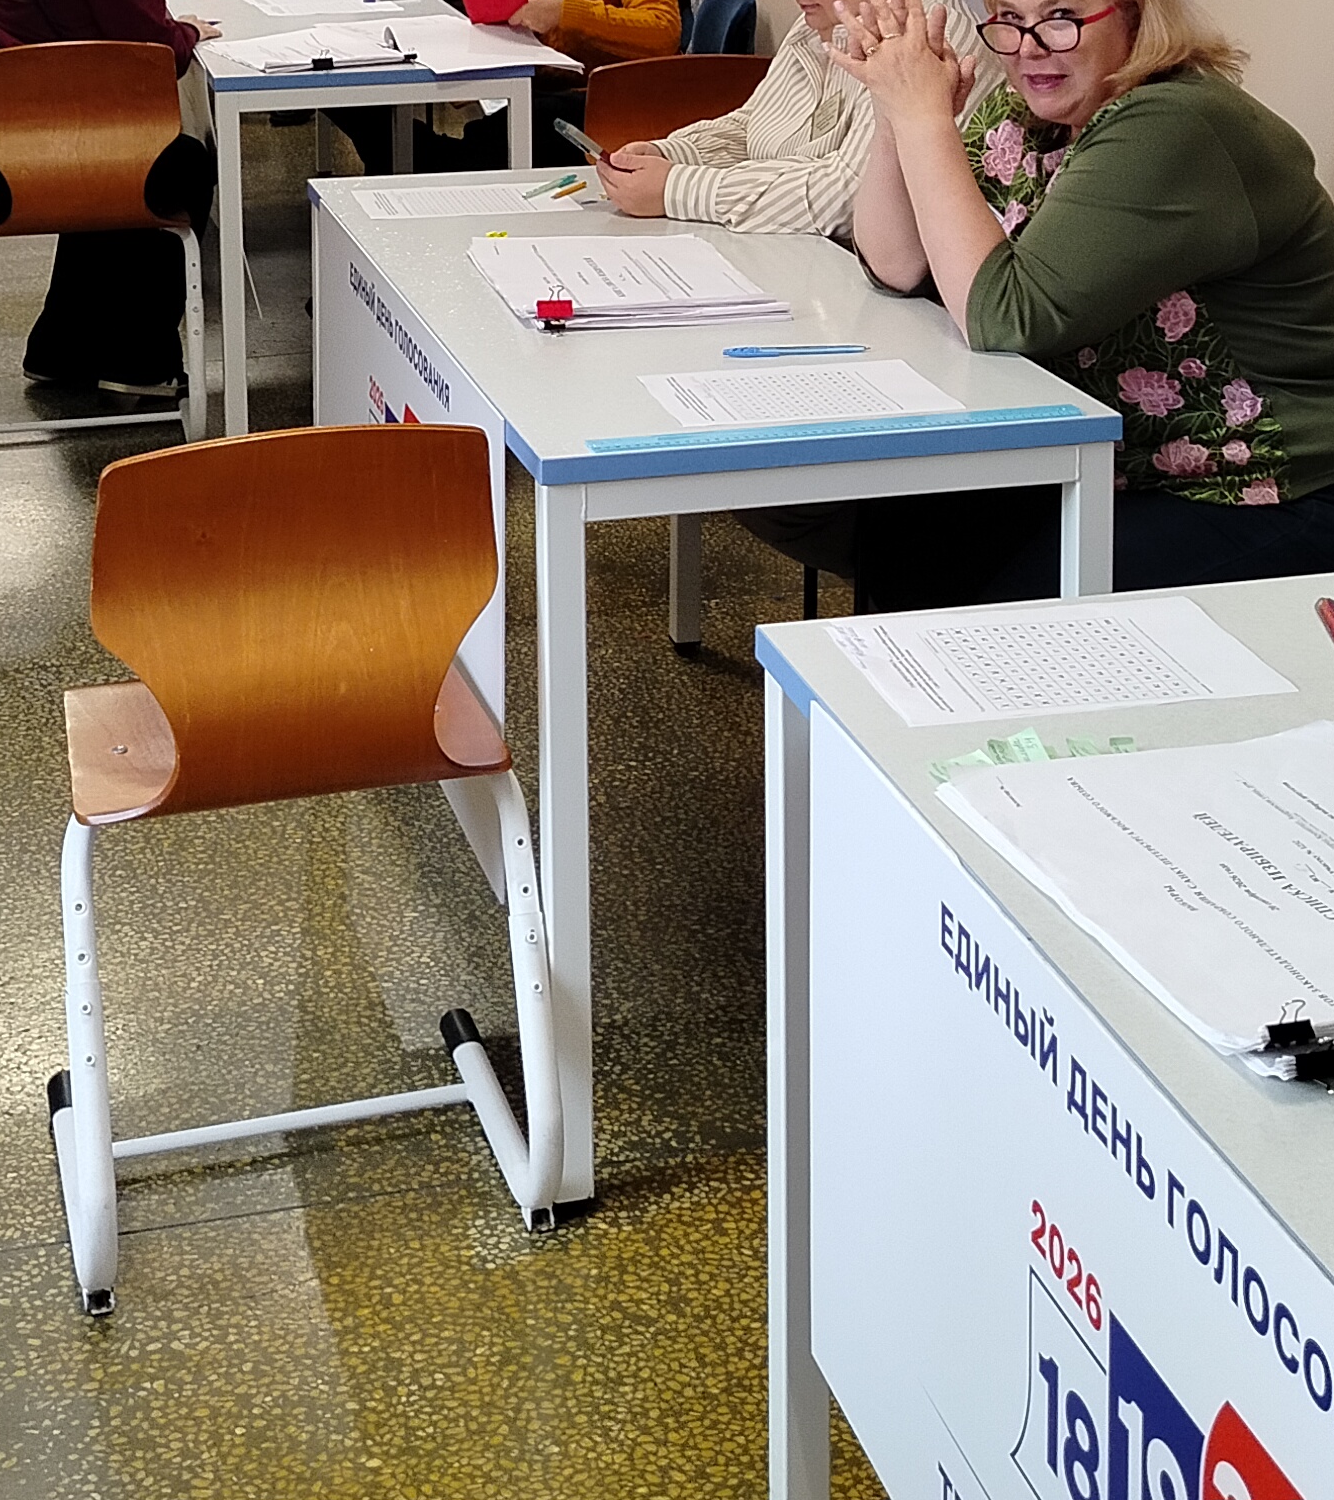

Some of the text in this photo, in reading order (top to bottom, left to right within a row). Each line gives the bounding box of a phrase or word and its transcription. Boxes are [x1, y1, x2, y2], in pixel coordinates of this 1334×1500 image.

[350, 261, 450, 412] ЕДИНЫЙ ДЕНЬ ГОЛОСОВАНИЯ
[1193, 812, 1286, 880] ИЗБИРАТЕЛЕЙ
[940, 901, 1060, 1088] ЕДИНЫЙ
[1067, 1055, 1156, 1200] ДЕНЬ
[1030, 1199, 1103, 1332] 2026
[1038, 1351, 1101, 1500] 18
